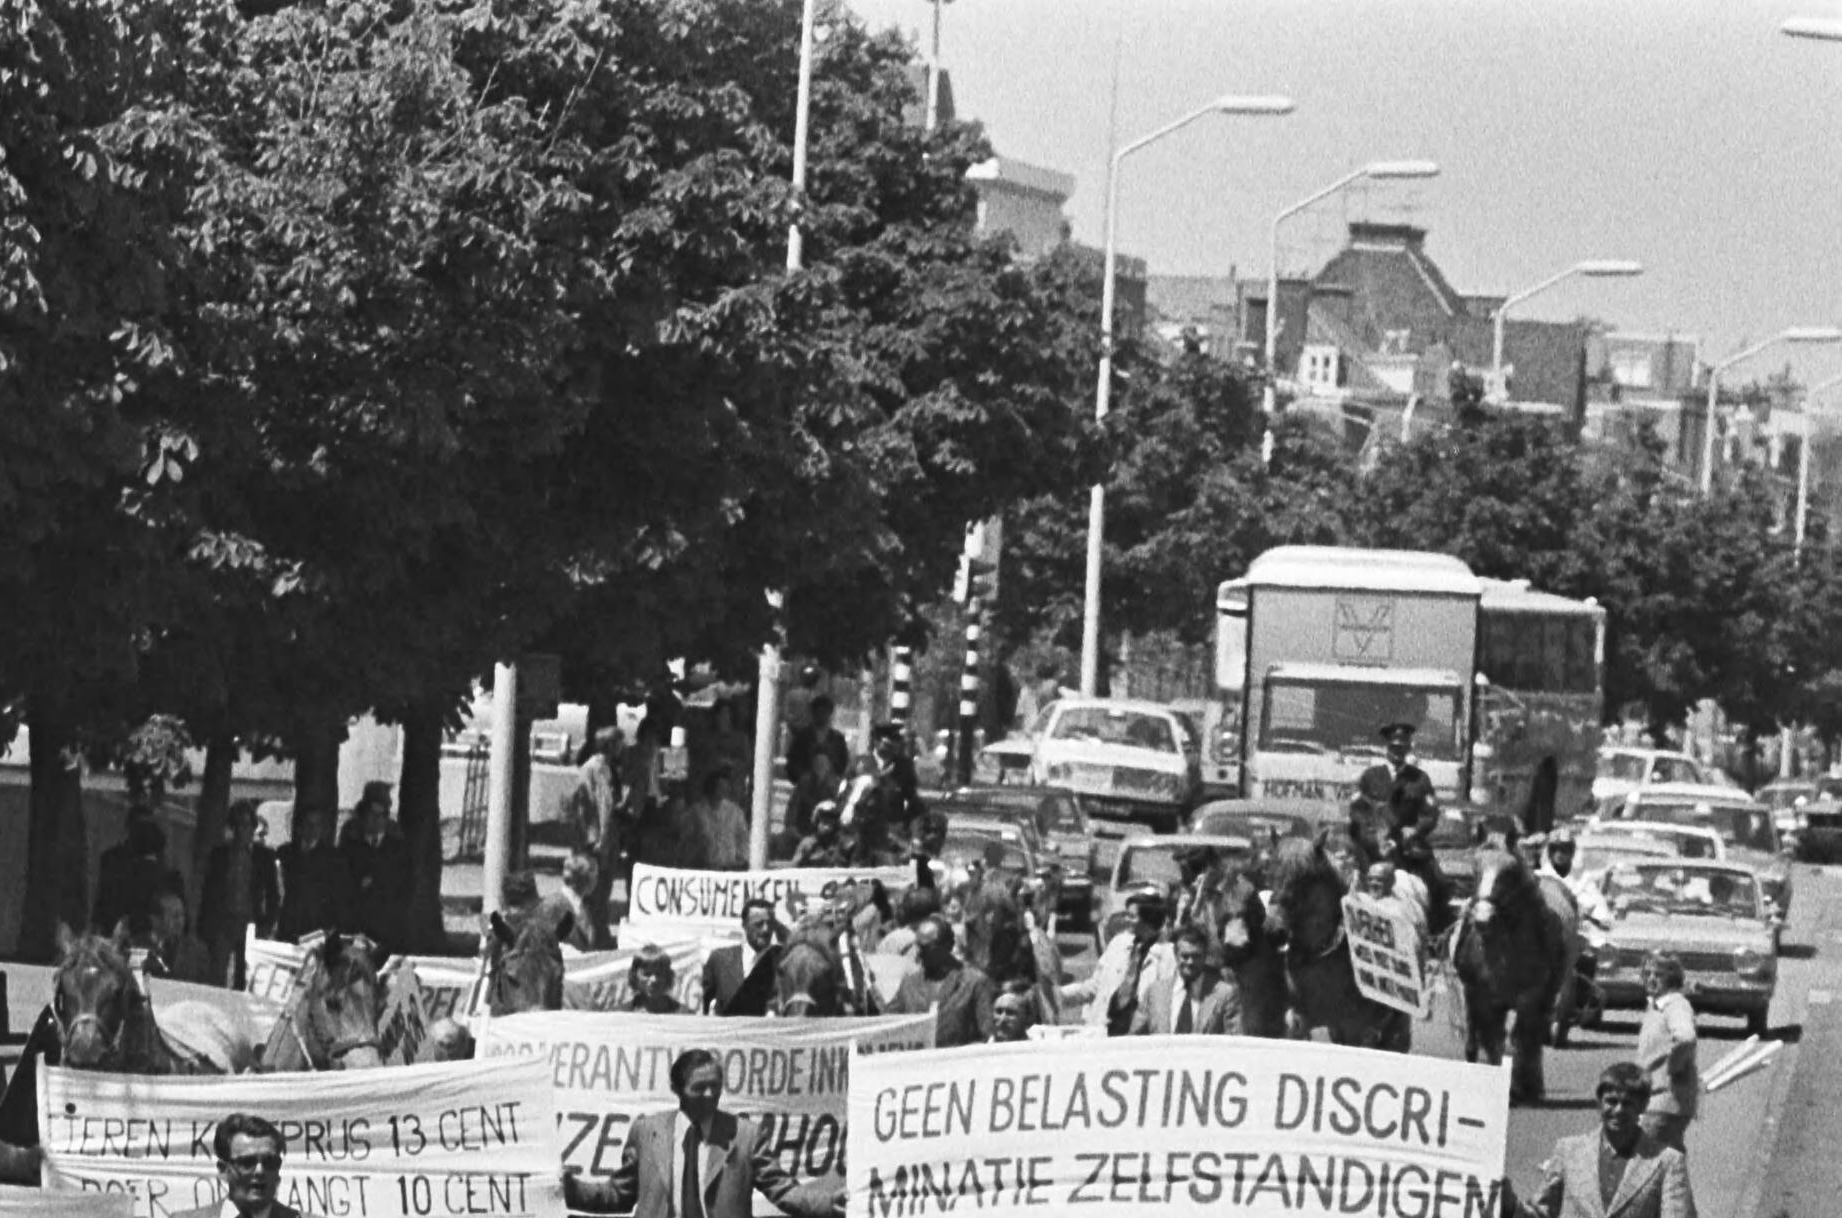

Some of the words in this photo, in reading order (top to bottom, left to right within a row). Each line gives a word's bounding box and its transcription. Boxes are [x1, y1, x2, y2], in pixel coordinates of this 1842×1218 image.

[191, 1117, 373, 1161] KPRIJS
[388, 1114, 421, 1158] 13
[439, 1101, 521, 1151] CENT
[874, 1079, 977, 1142] GEEN
[988, 1069, 1248, 1132] BELASTING
[1275, 1073, 1486, 1147] DISCRI-
[194, 1174, 370, 1217] OANGT
[397, 1174, 431, 1217] 10
[444, 1173, 532, 1215] CENT
